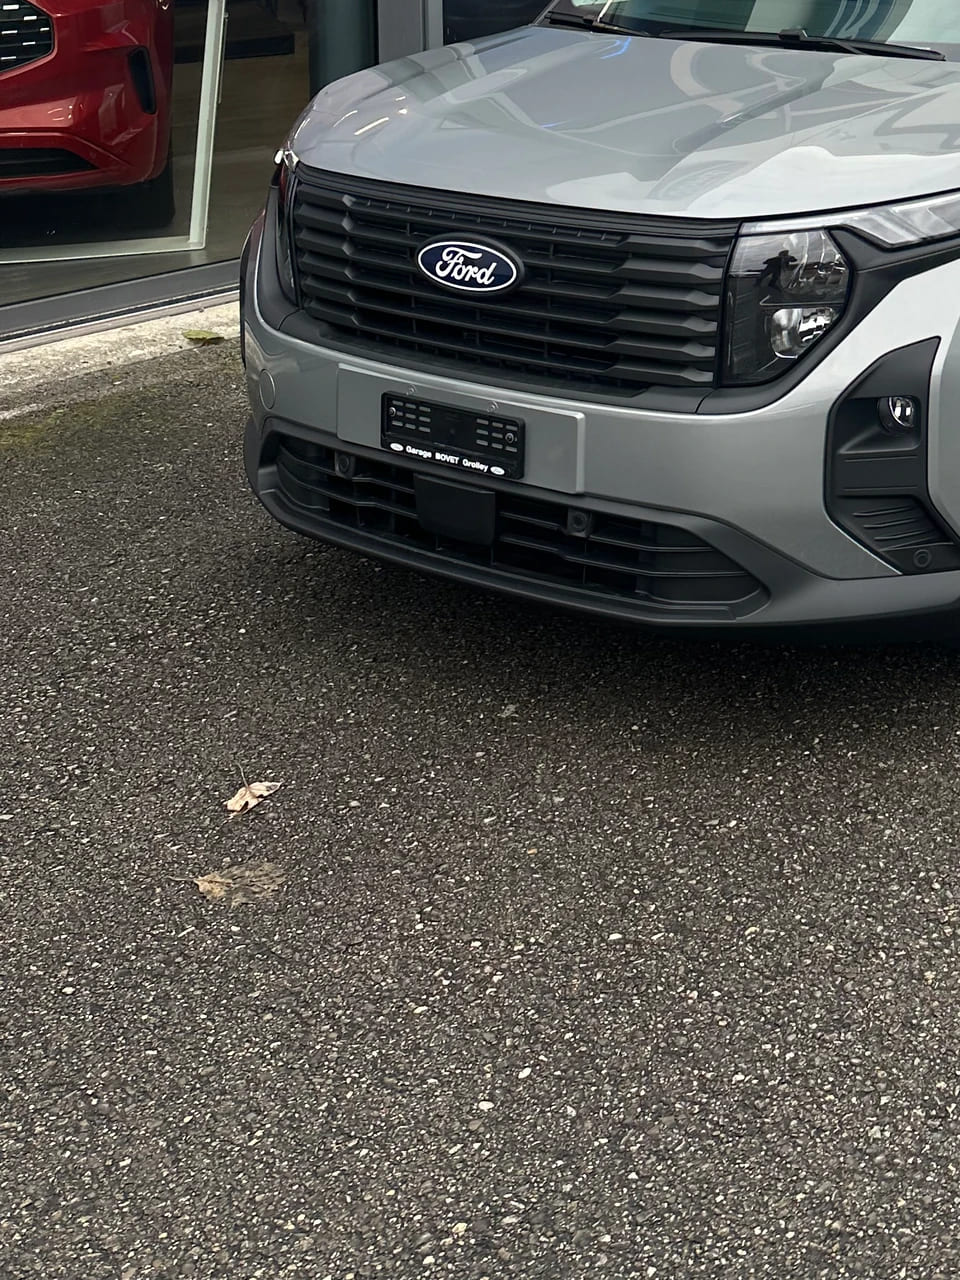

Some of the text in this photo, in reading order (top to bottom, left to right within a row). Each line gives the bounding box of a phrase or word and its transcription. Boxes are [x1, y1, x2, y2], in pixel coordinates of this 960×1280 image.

[435, 246, 497, 285] Ford
[405, 445, 432, 459] Garage
[435, 452, 460, 465] BOVET
